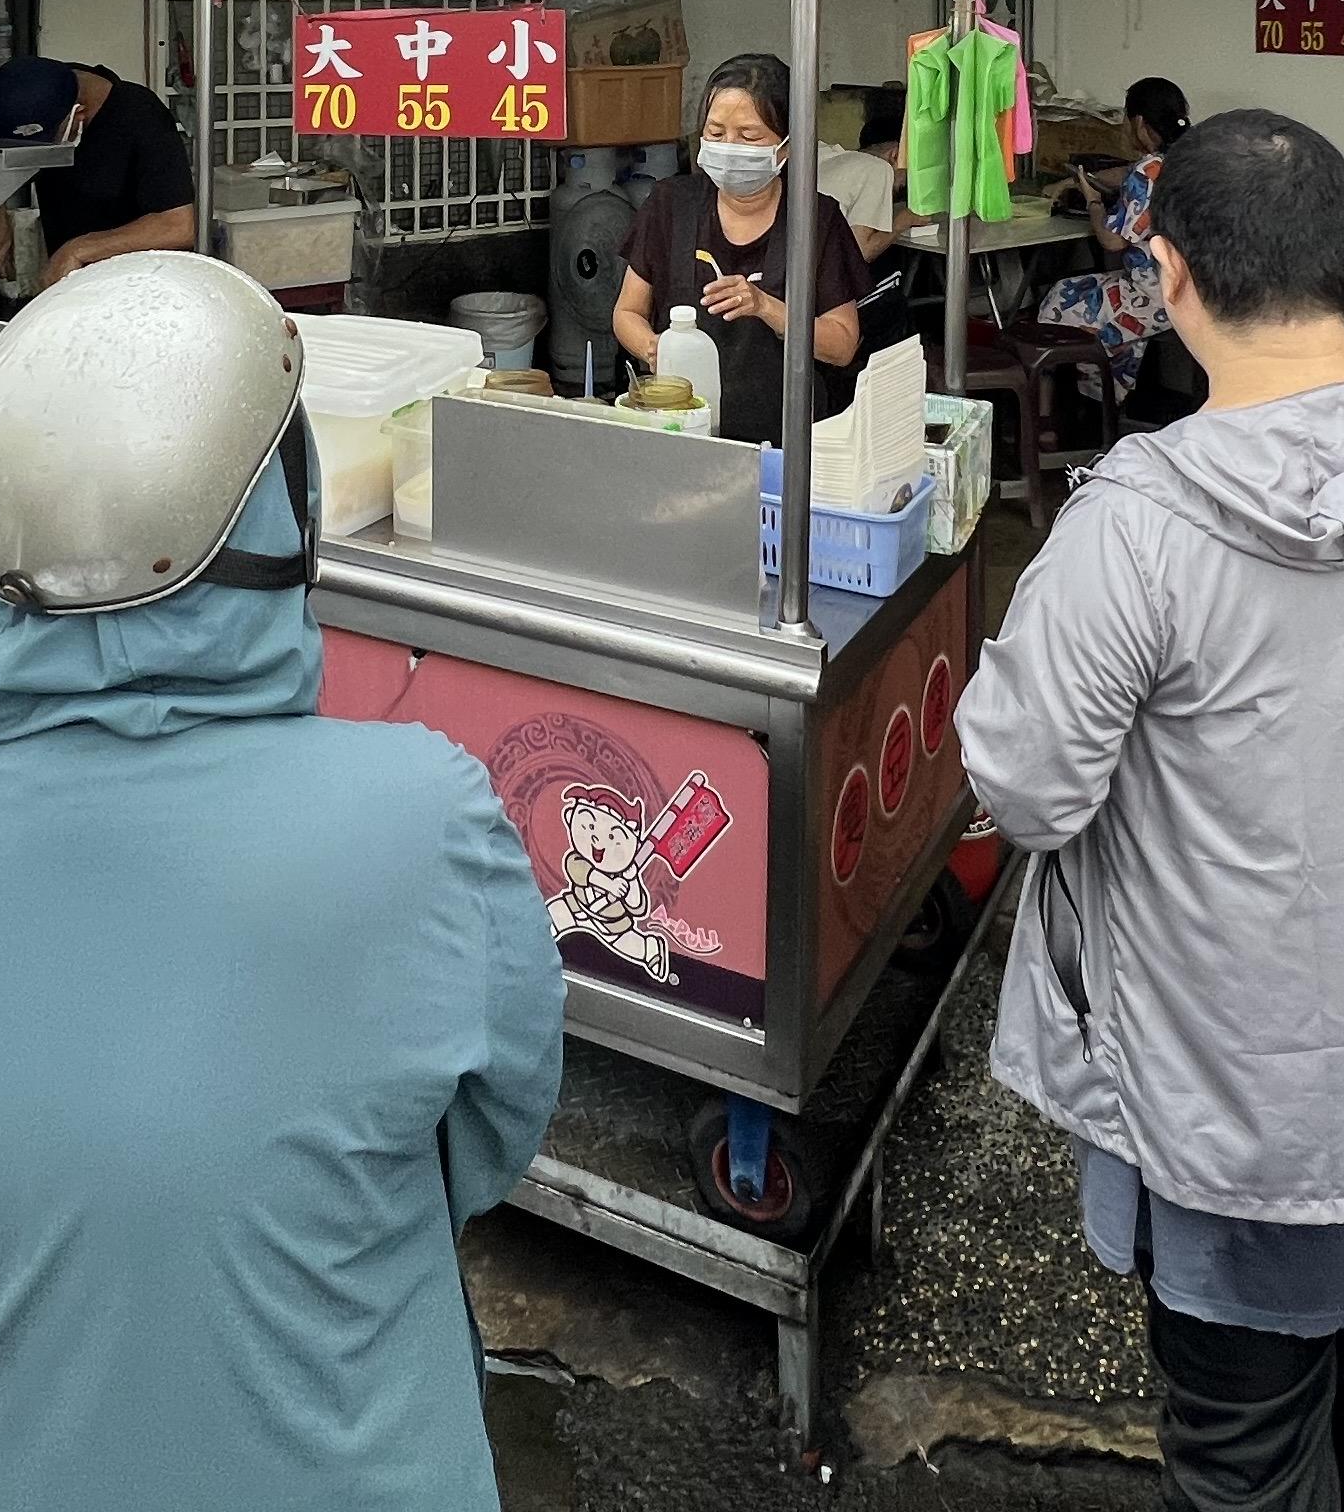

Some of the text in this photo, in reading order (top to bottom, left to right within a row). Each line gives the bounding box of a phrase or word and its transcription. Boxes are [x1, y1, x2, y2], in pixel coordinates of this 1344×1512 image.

[302, 25, 363, 78] 大
[394, 20, 452, 81] 中
[488, 19, 557, 80] 小
[1260, 21, 1283, 49] 70
[1300, 22, 1324, 51] 55
[304, 84, 549, 132] 70 55 45
